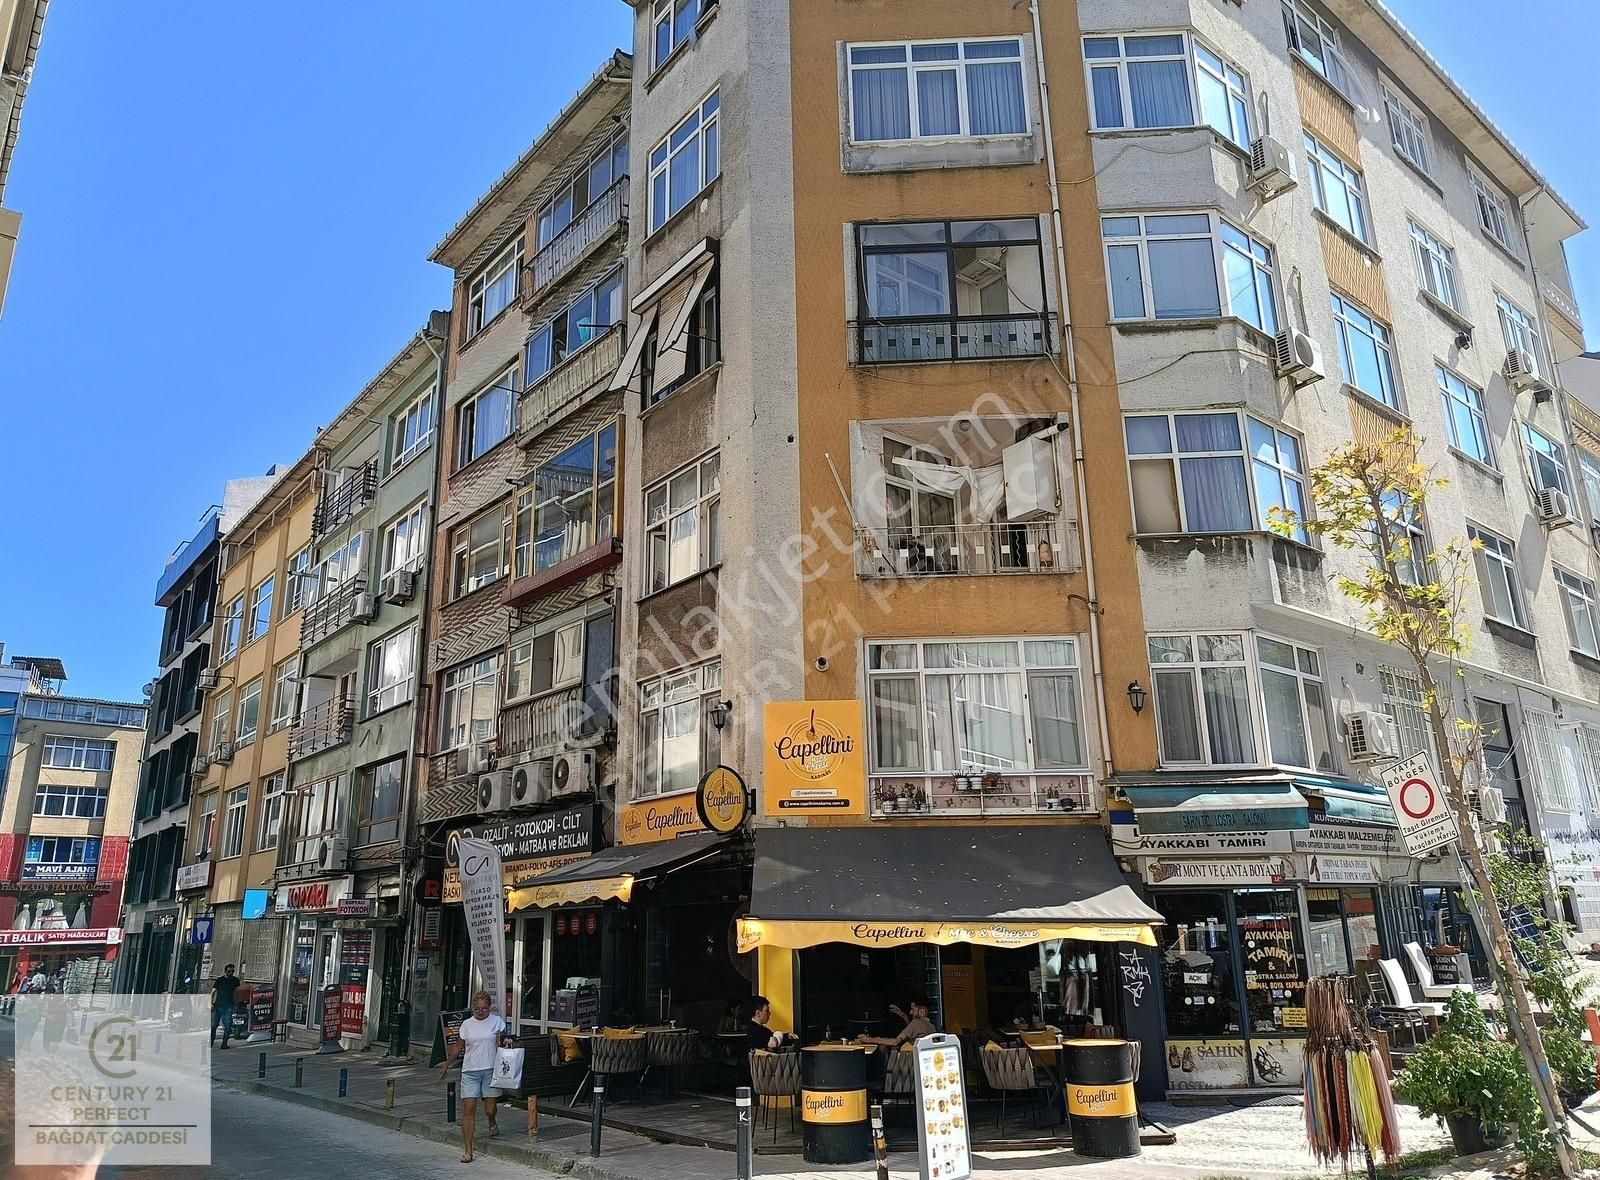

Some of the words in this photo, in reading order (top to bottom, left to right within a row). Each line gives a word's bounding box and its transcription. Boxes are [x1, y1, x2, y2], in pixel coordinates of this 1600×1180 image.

[774, 735, 853, 765] Capellini
[1392, 760, 1416, 775] YAYA
[705, 790, 742, 812] Capellini
[483, 823, 509, 842] OZALİT
[514, 814, 556, 837] FOTOKOPİ
[562, 811, 581, 830] CİLT
[645, 806, 693, 837] Capellini
[1421, 811, 1448, 826] Giremez
[518, 838, 547, 854] MATBAA
[548, 839, 556, 851] ve
[558, 832, 589, 849] REKLAM
[1140, 839, 1210, 849] AYAKKABI
[1309, 829, 1346, 840] AYAKKABI
[1409, 838, 1437, 852] Araçları
[1437, 830, 1457, 842] Hariç
[36, 865, 63, 873] MAVİ
[1183, 864, 1207, 877] MONT
[1208, 864, 1219, 877] VE
[1220, 864, 1248, 880] ÇANTA
[12, 933, 45, 943] BALIK
[47, 932, 67, 940] SATIŞ
[67, 930, 107, 940] MAĞAZALARI
[850, 924, 926, 943] Capellini
[978, 929, 989, 938] &
[989, 924, 1039, 939] Cheese
[1268, 961, 1276, 971] &
[805, 1094, 844, 1115] Capellini
[1075, 1089, 1119, 1108] Capellini
